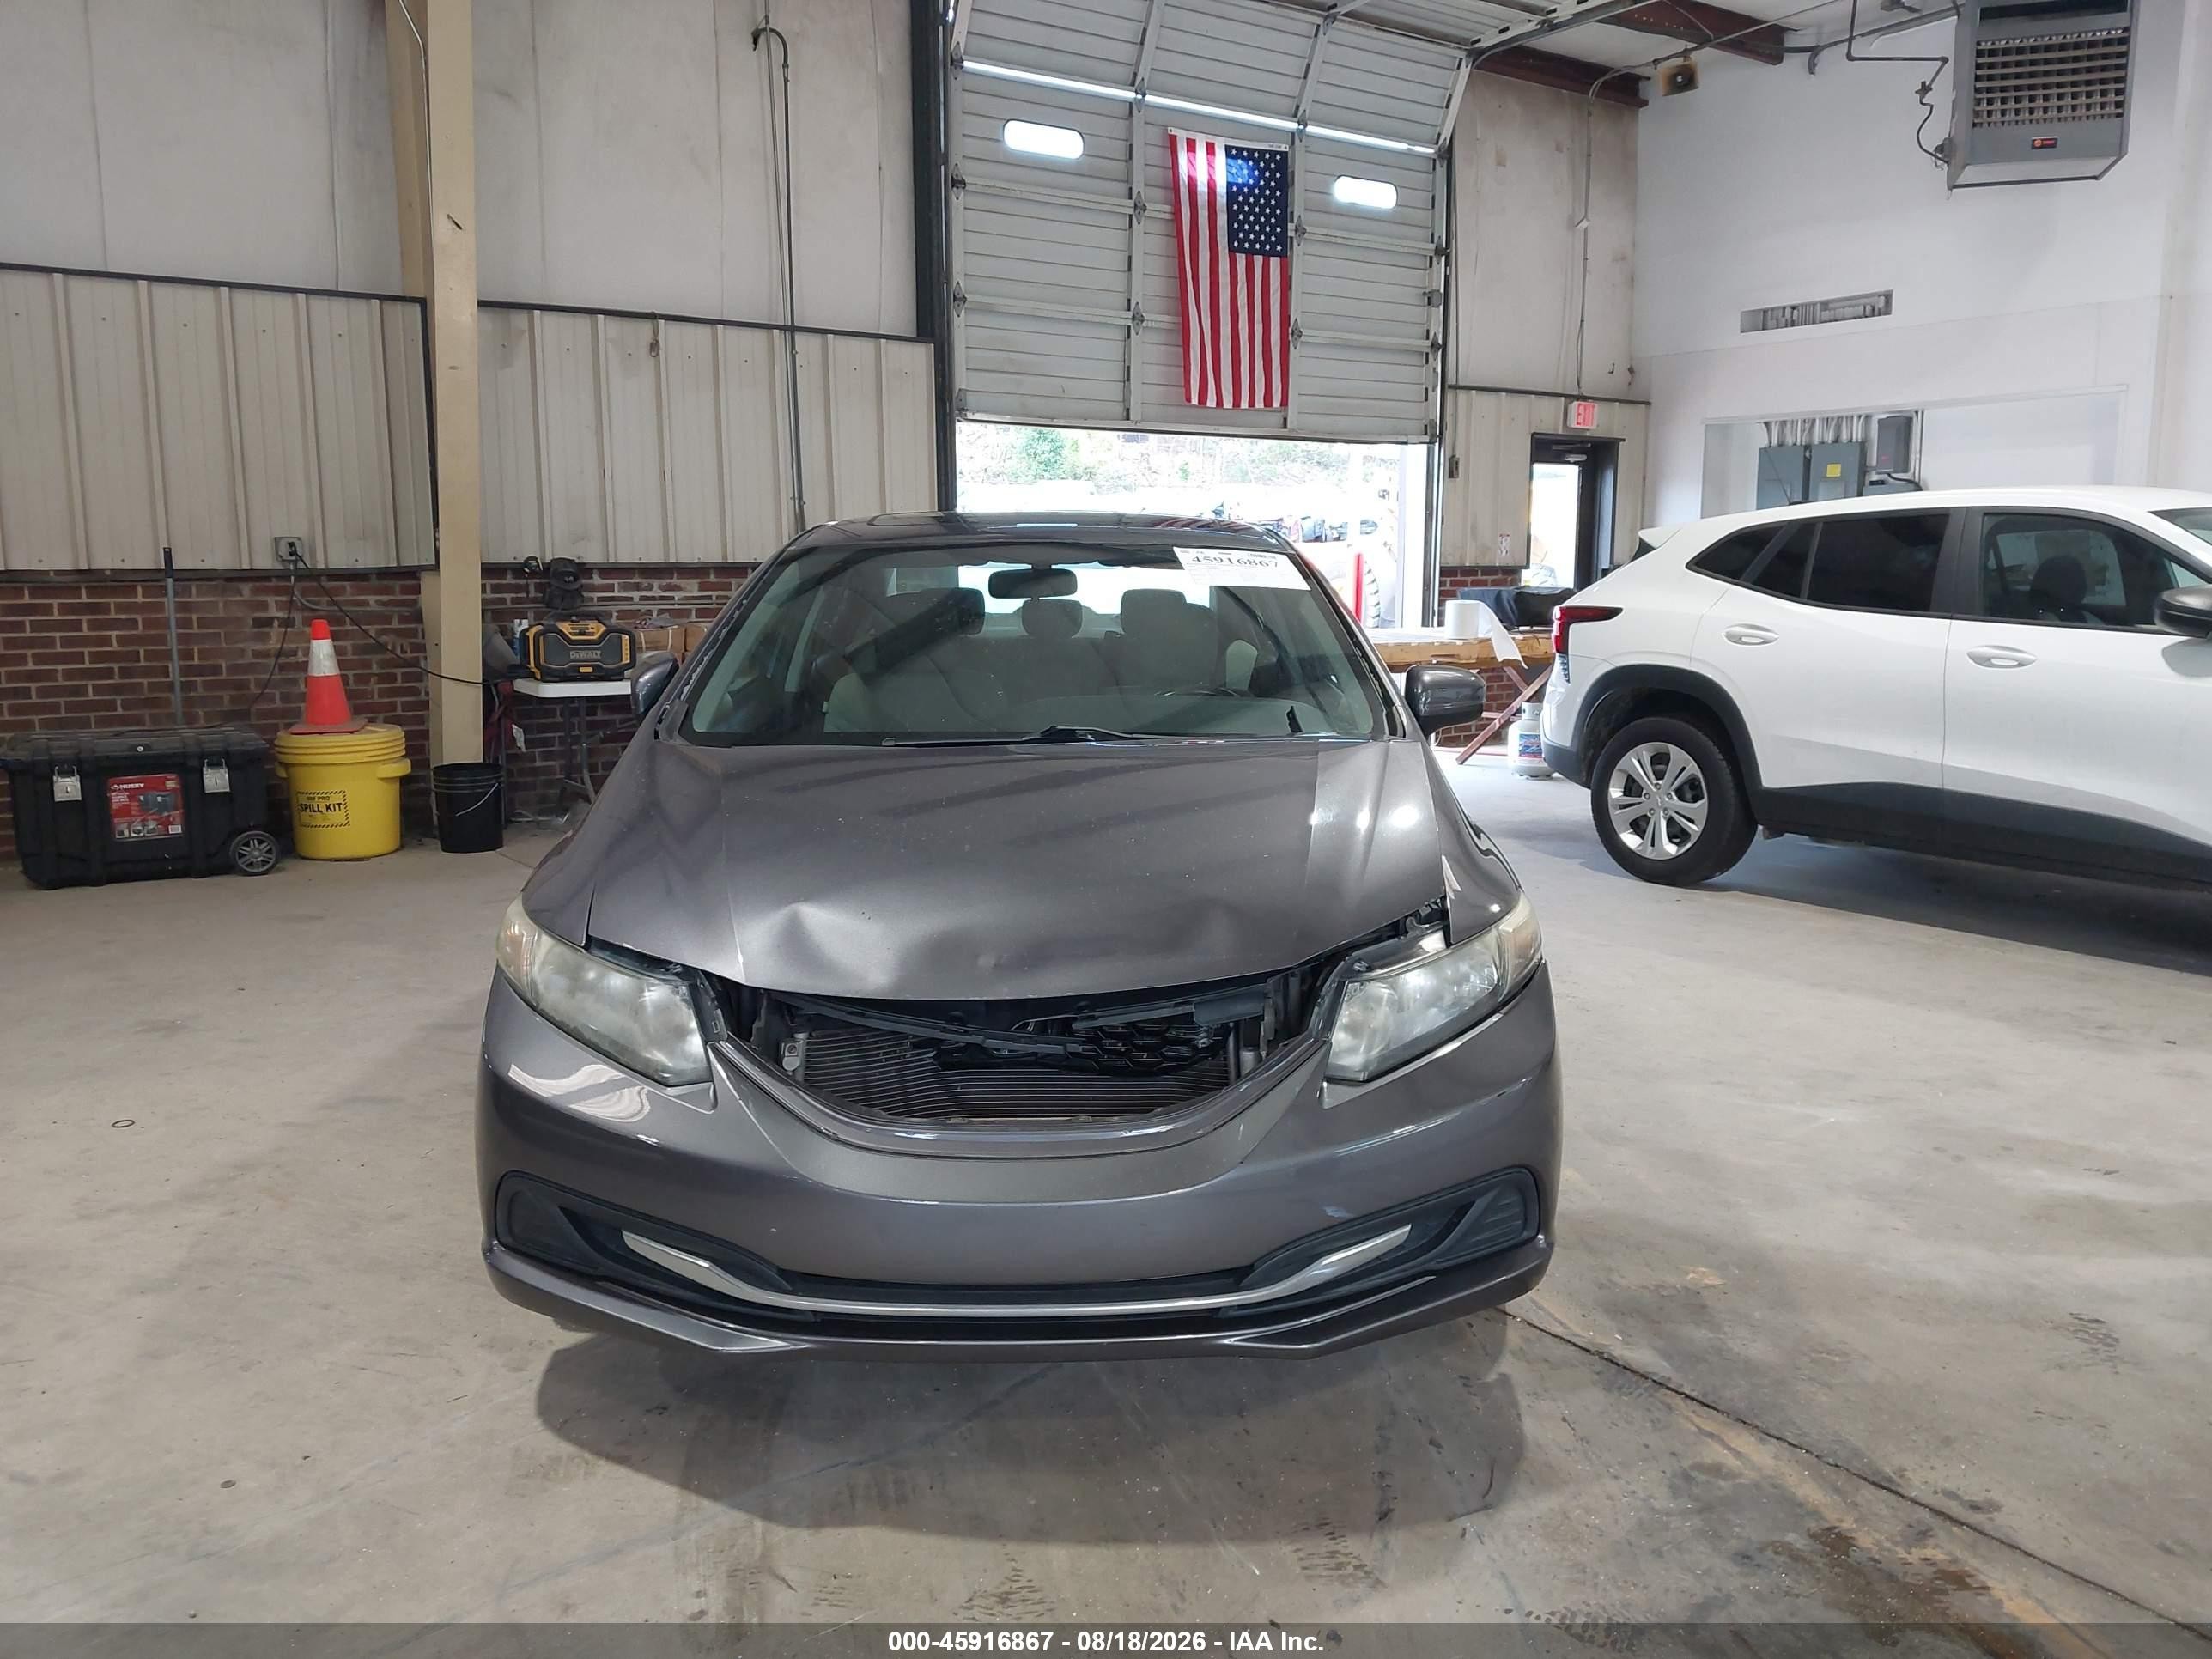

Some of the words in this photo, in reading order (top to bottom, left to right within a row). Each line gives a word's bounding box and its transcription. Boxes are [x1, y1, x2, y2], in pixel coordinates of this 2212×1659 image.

[1192, 556, 1278, 568] 45916867
[300, 803, 323, 813] SPILL
[325, 802, 343, 812] KIT
